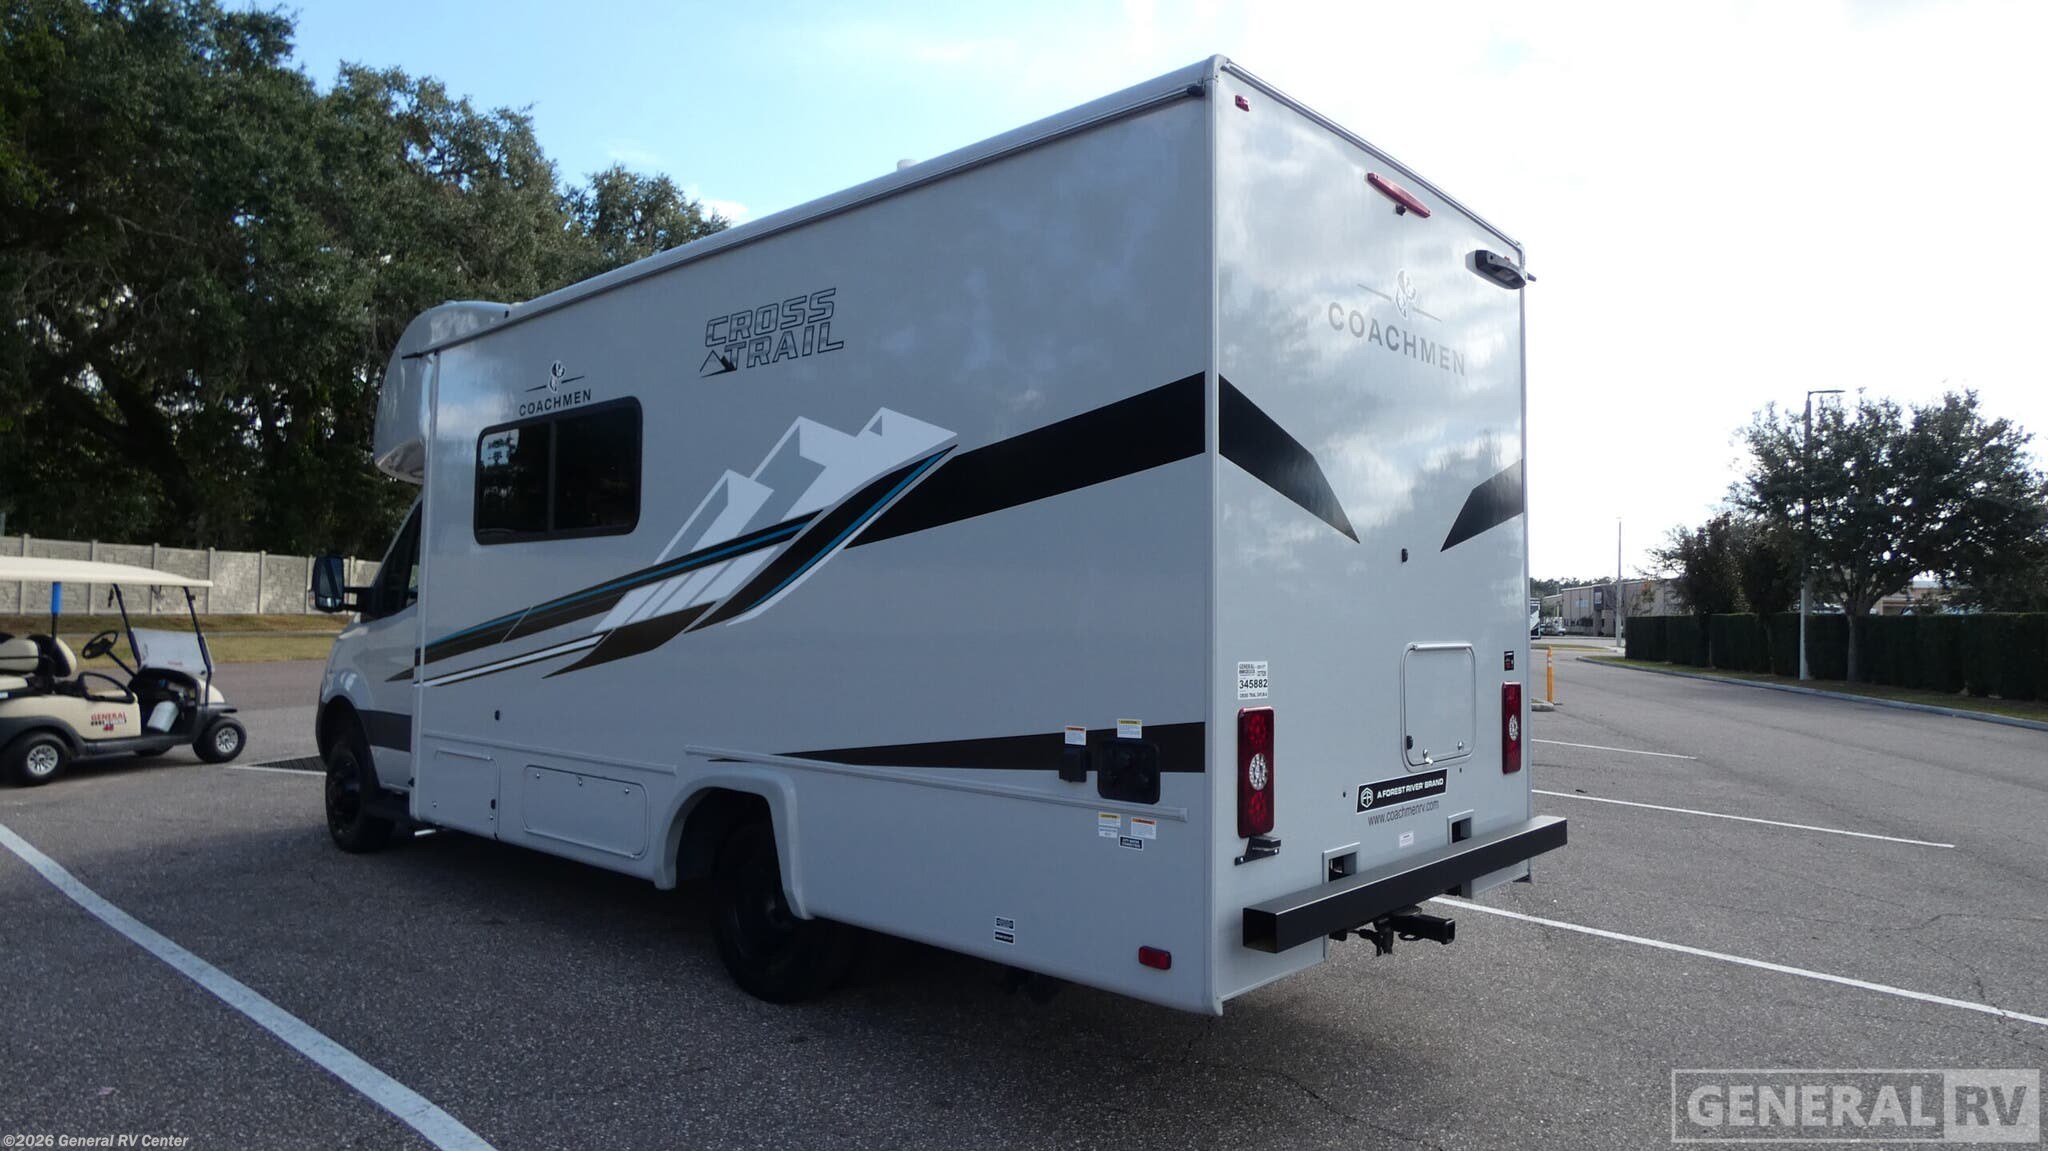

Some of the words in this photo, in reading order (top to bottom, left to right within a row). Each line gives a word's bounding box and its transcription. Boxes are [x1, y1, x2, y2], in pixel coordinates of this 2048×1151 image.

[705, 287, 836, 347] CROSS
[724, 321, 844, 369] TRAIL
[1328, 302, 1465, 376] COACHMEN
[519, 389, 591, 416] COACHMEN
[1239, 678, 1268, 689] 345882
[91, 711, 126, 721] GENERAL
[1377, 790, 1383, 799] A
[1382, 786, 1405, 798] FOREST
[1406, 782, 1424, 793] RIVER
[1424, 777, 1444, 789] BRAND
[1368, 800, 1439, 826] www.coachmenrv.com
